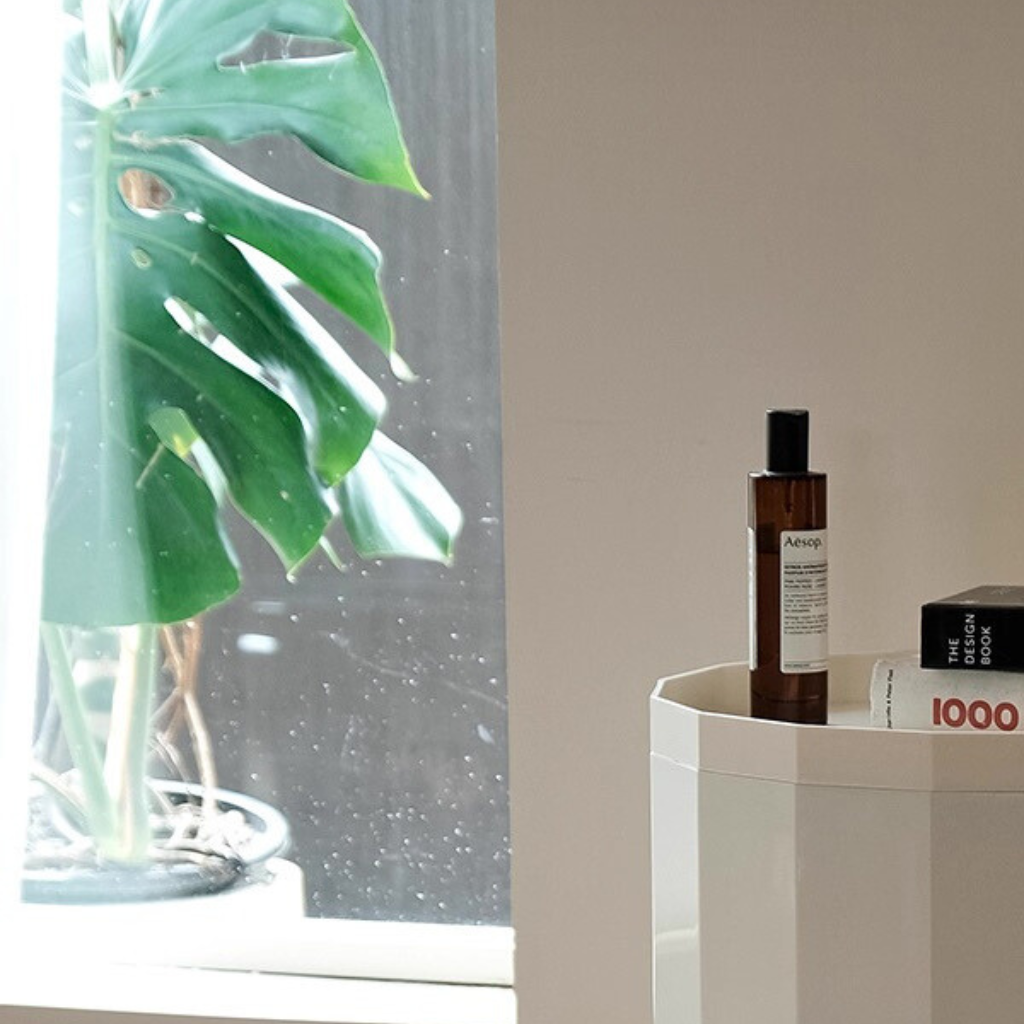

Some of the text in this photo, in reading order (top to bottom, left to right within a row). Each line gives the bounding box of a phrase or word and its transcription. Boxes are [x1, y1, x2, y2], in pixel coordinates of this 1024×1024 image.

[949, 638, 959, 664] THE
[964, 614, 975, 665] DESIGN
[981, 626, 991, 665] BOOK
[933, 698, 1019, 732] 1000
